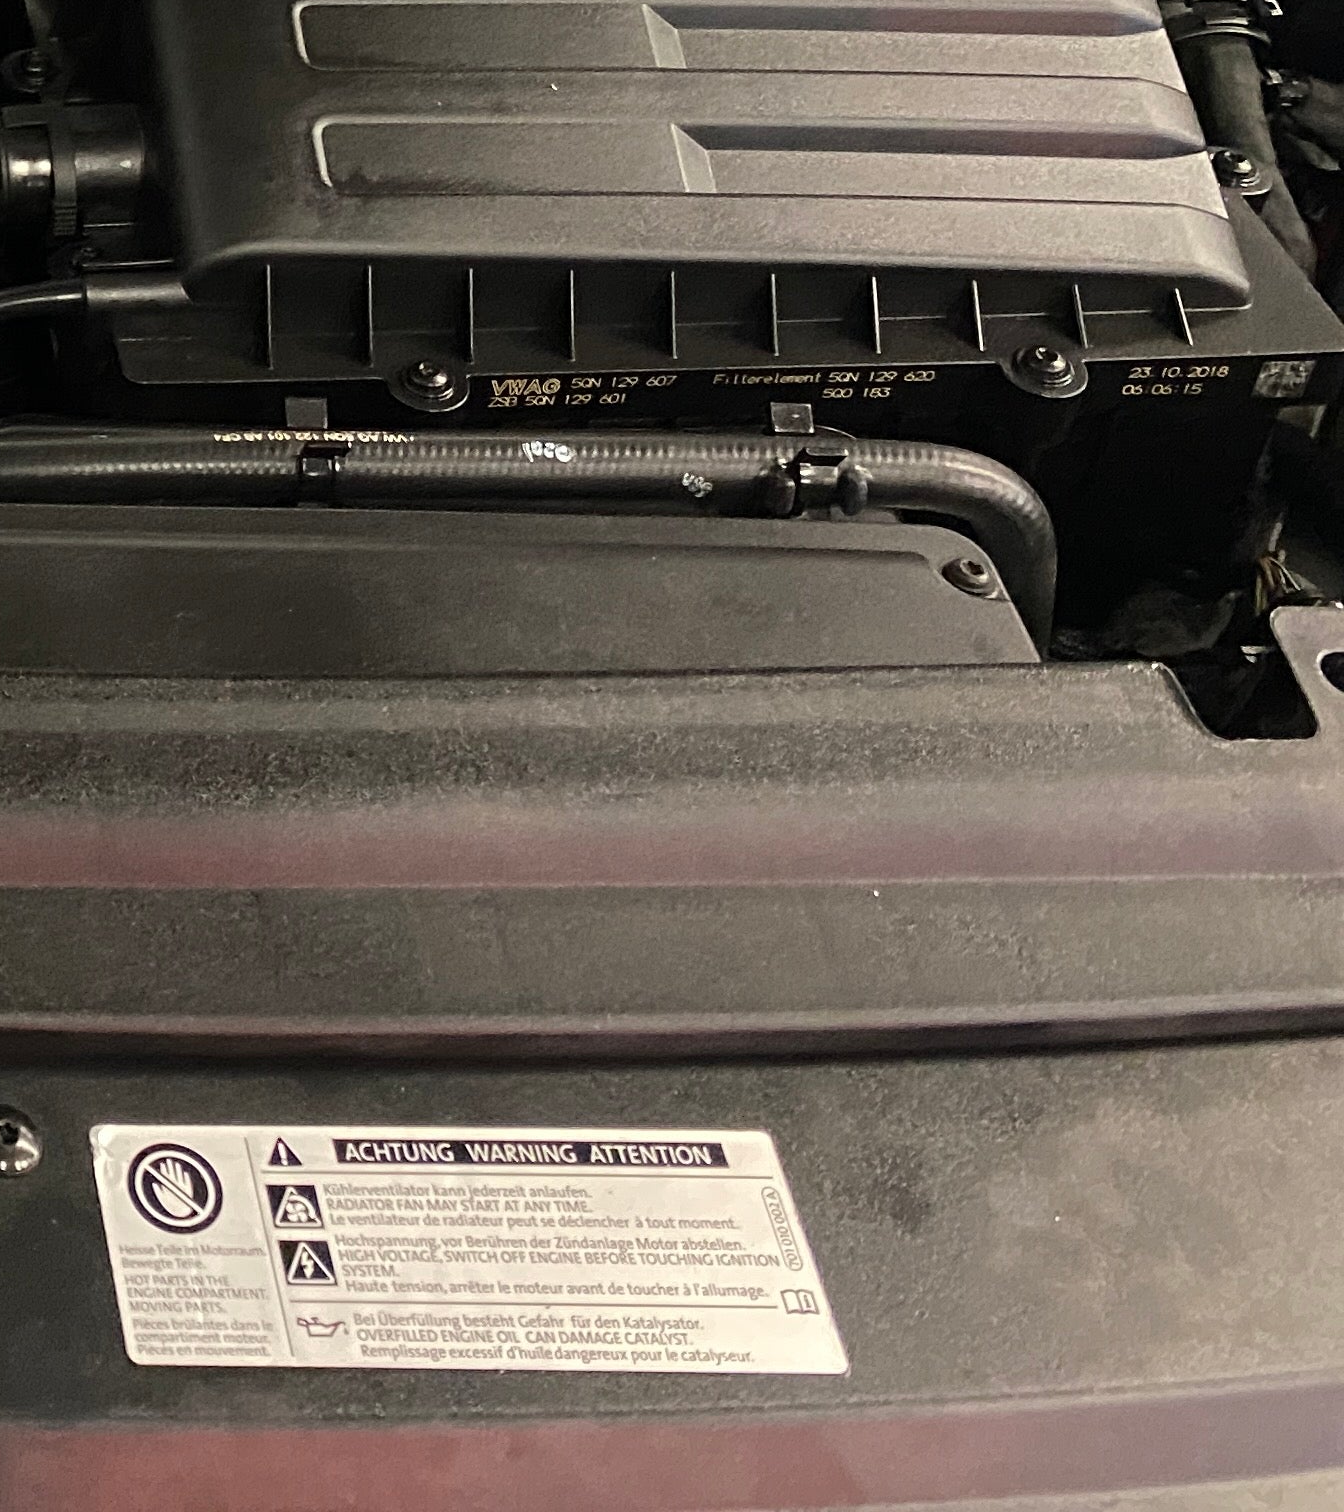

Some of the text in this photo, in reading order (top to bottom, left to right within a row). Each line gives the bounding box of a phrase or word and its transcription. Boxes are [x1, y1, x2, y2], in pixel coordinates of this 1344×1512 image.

[571, 377, 602, 388] 5QN
[612, 376, 639, 387] 129
[646, 375, 677, 386] 607
[713, 370, 935, 384] Filterelement 5QN 129 620
[565, 394, 592, 405] 129
[599, 393, 626, 404] 601
[863, 388, 891, 398] 183
[345, 1142, 711, 1164] ACHTUNG WARNING ATTENTION
[322, 1183, 592, 1201] Kühlerventilator kann jederzeit anlaufen.
[326, 1198, 593, 1213] RADIATOR FAN MAY START AT ANY TIME.
[329, 1212, 739, 1230] Le ventilateur de radiateur peut se déclencher à tout moment.
[334, 1234, 745, 1253] Hochspannung, vor Berühren der Zündanlage Motor abstellen.
[337, 1249, 780, 1266] HIGH VOLTAGE, SWITCH OFF ENGINE BEFORE TOUCHING IGNITION
[341, 1264, 399, 1277] SYSTEM.
[345, 1279, 768, 1300] Haute tension, arrêter le moteur avant de toucher à l'allumage.
[352, 1311, 703, 1334] Bei Überfüllung besteht Gefahr für den Katalysator.
[356, 1328, 692, 1345] OVERFILLED ENGINE OIL CAN DAMAGE CATALYST.
[360, 1344, 753, 1365] Remplissage excessif d'huile dangereux pour le catalyseur.
